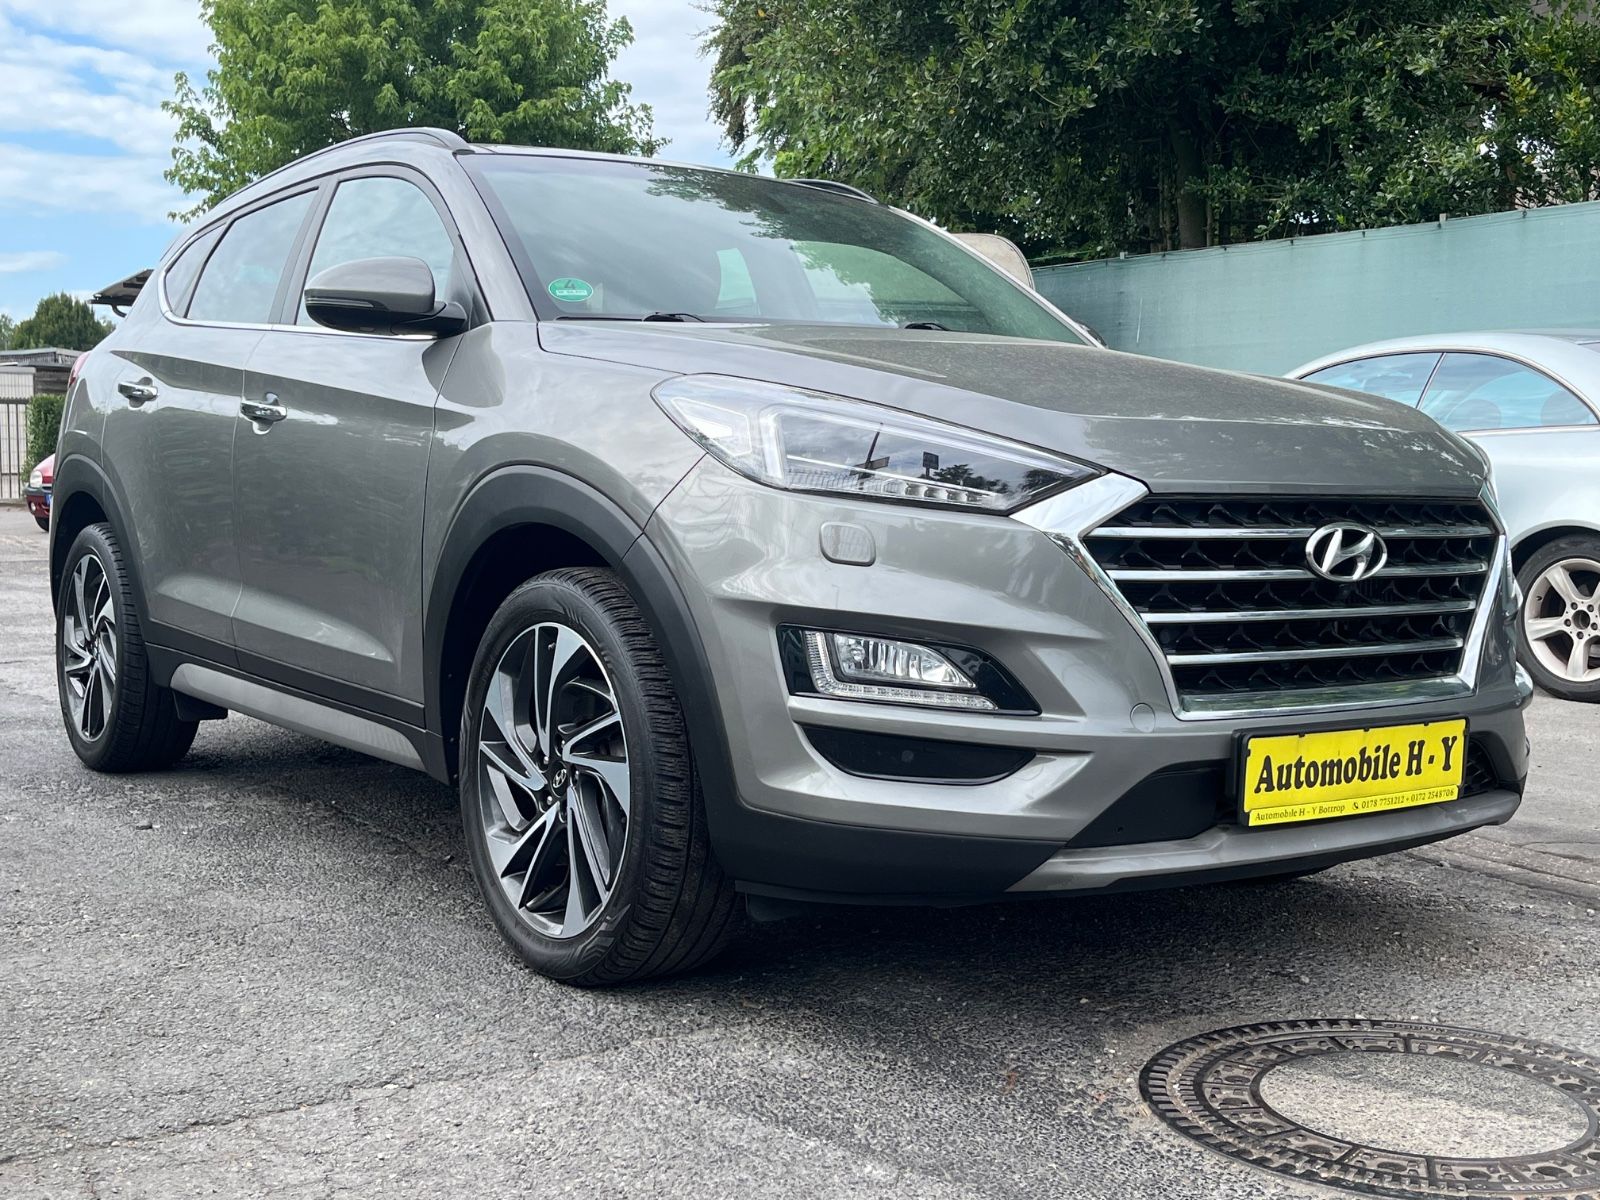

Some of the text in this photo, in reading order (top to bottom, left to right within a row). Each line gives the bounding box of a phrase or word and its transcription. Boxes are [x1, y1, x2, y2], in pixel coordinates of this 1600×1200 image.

[1254, 744, 1401, 794] Automobile
[1405, 739, 1426, 777] H
[1441, 736, 1458, 772] Y
[1255, 810, 1298, 821] Automobile
[1298, 808, 1306, 817] H
[1312, 806, 1318, 815] Y
[1318, 804, 1345, 815] Bottrop
[1361, 799, 1378, 809] 0178
[1410, 792, 1426, 803] 0172
